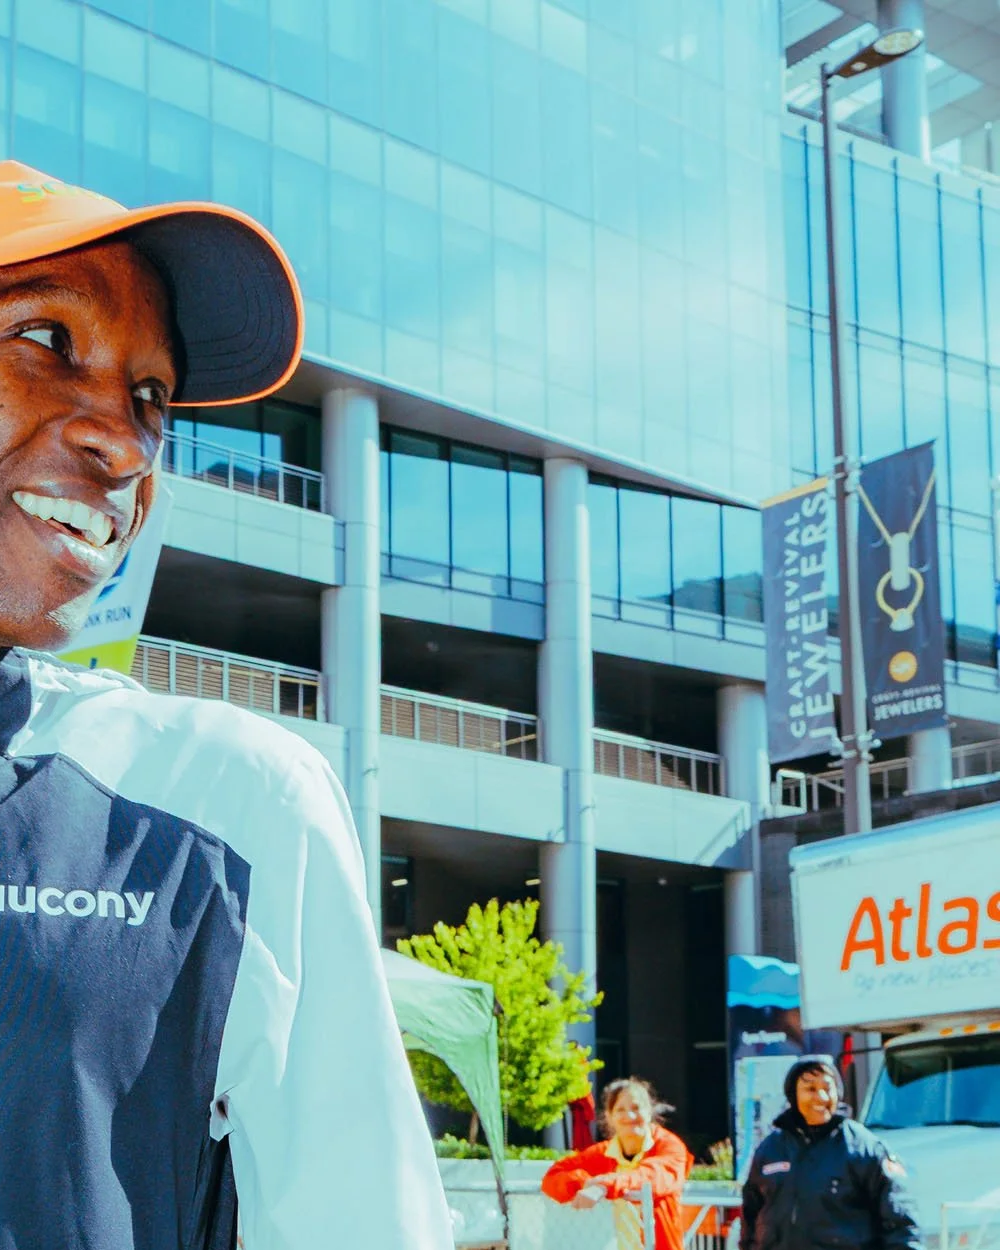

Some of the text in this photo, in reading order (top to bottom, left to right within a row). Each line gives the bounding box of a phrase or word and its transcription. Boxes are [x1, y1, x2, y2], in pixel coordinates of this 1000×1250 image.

[106, 606, 131, 623] RUN
[801, 490, 837, 740] JEWELERS
[874, 694, 943, 721] JEWELERS
